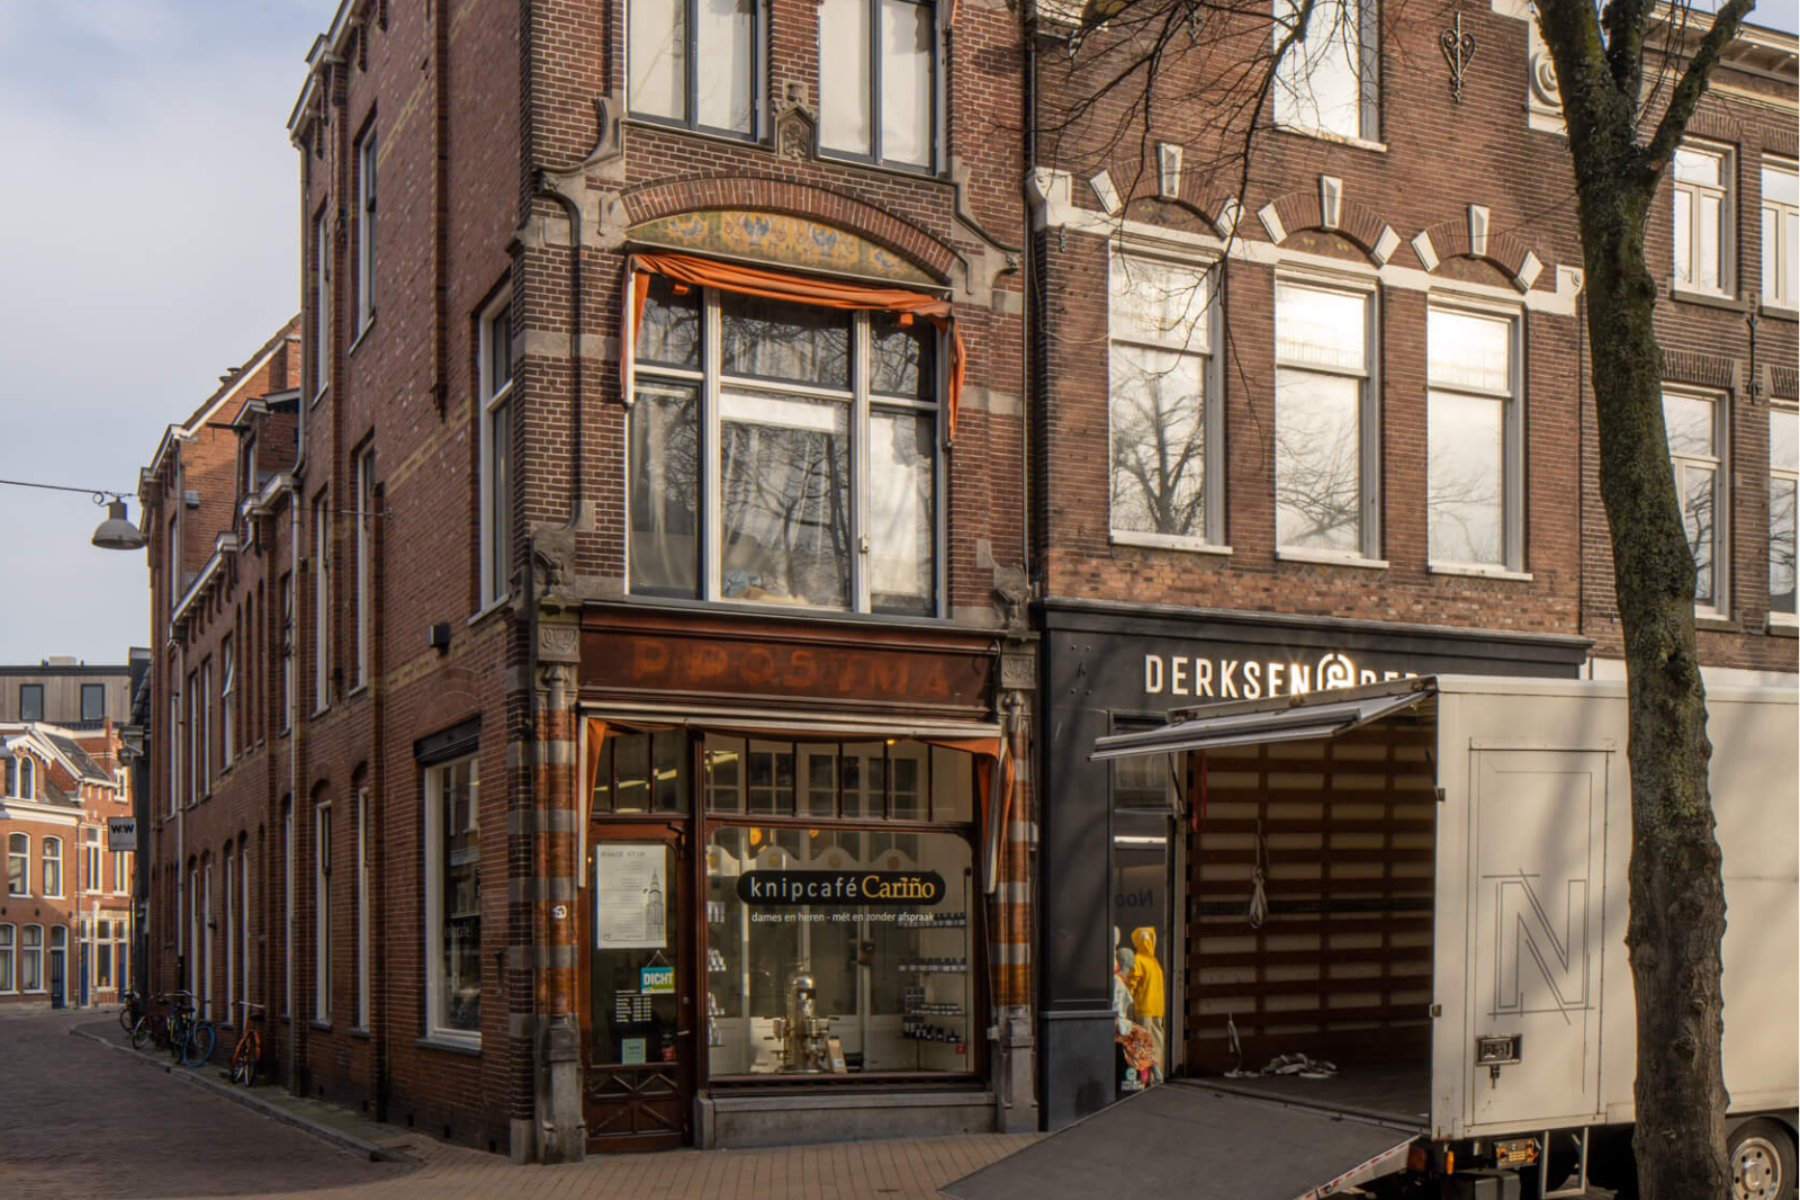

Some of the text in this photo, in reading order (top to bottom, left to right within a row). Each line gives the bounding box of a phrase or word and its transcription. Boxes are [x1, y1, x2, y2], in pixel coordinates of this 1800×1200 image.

[750, 875, 936, 901] knipcafé Cariño
[751, 912, 783, 922] dames
[784, 914, 796, 922] en
[798, 912, 825, 922] heren
[832, 911, 850, 922] mét
[852, 914, 864, 922] en
[865, 912, 896, 922] zonder
[897, 912, 935, 925] afspraak
[643, 972, 674, 986] DICHT
